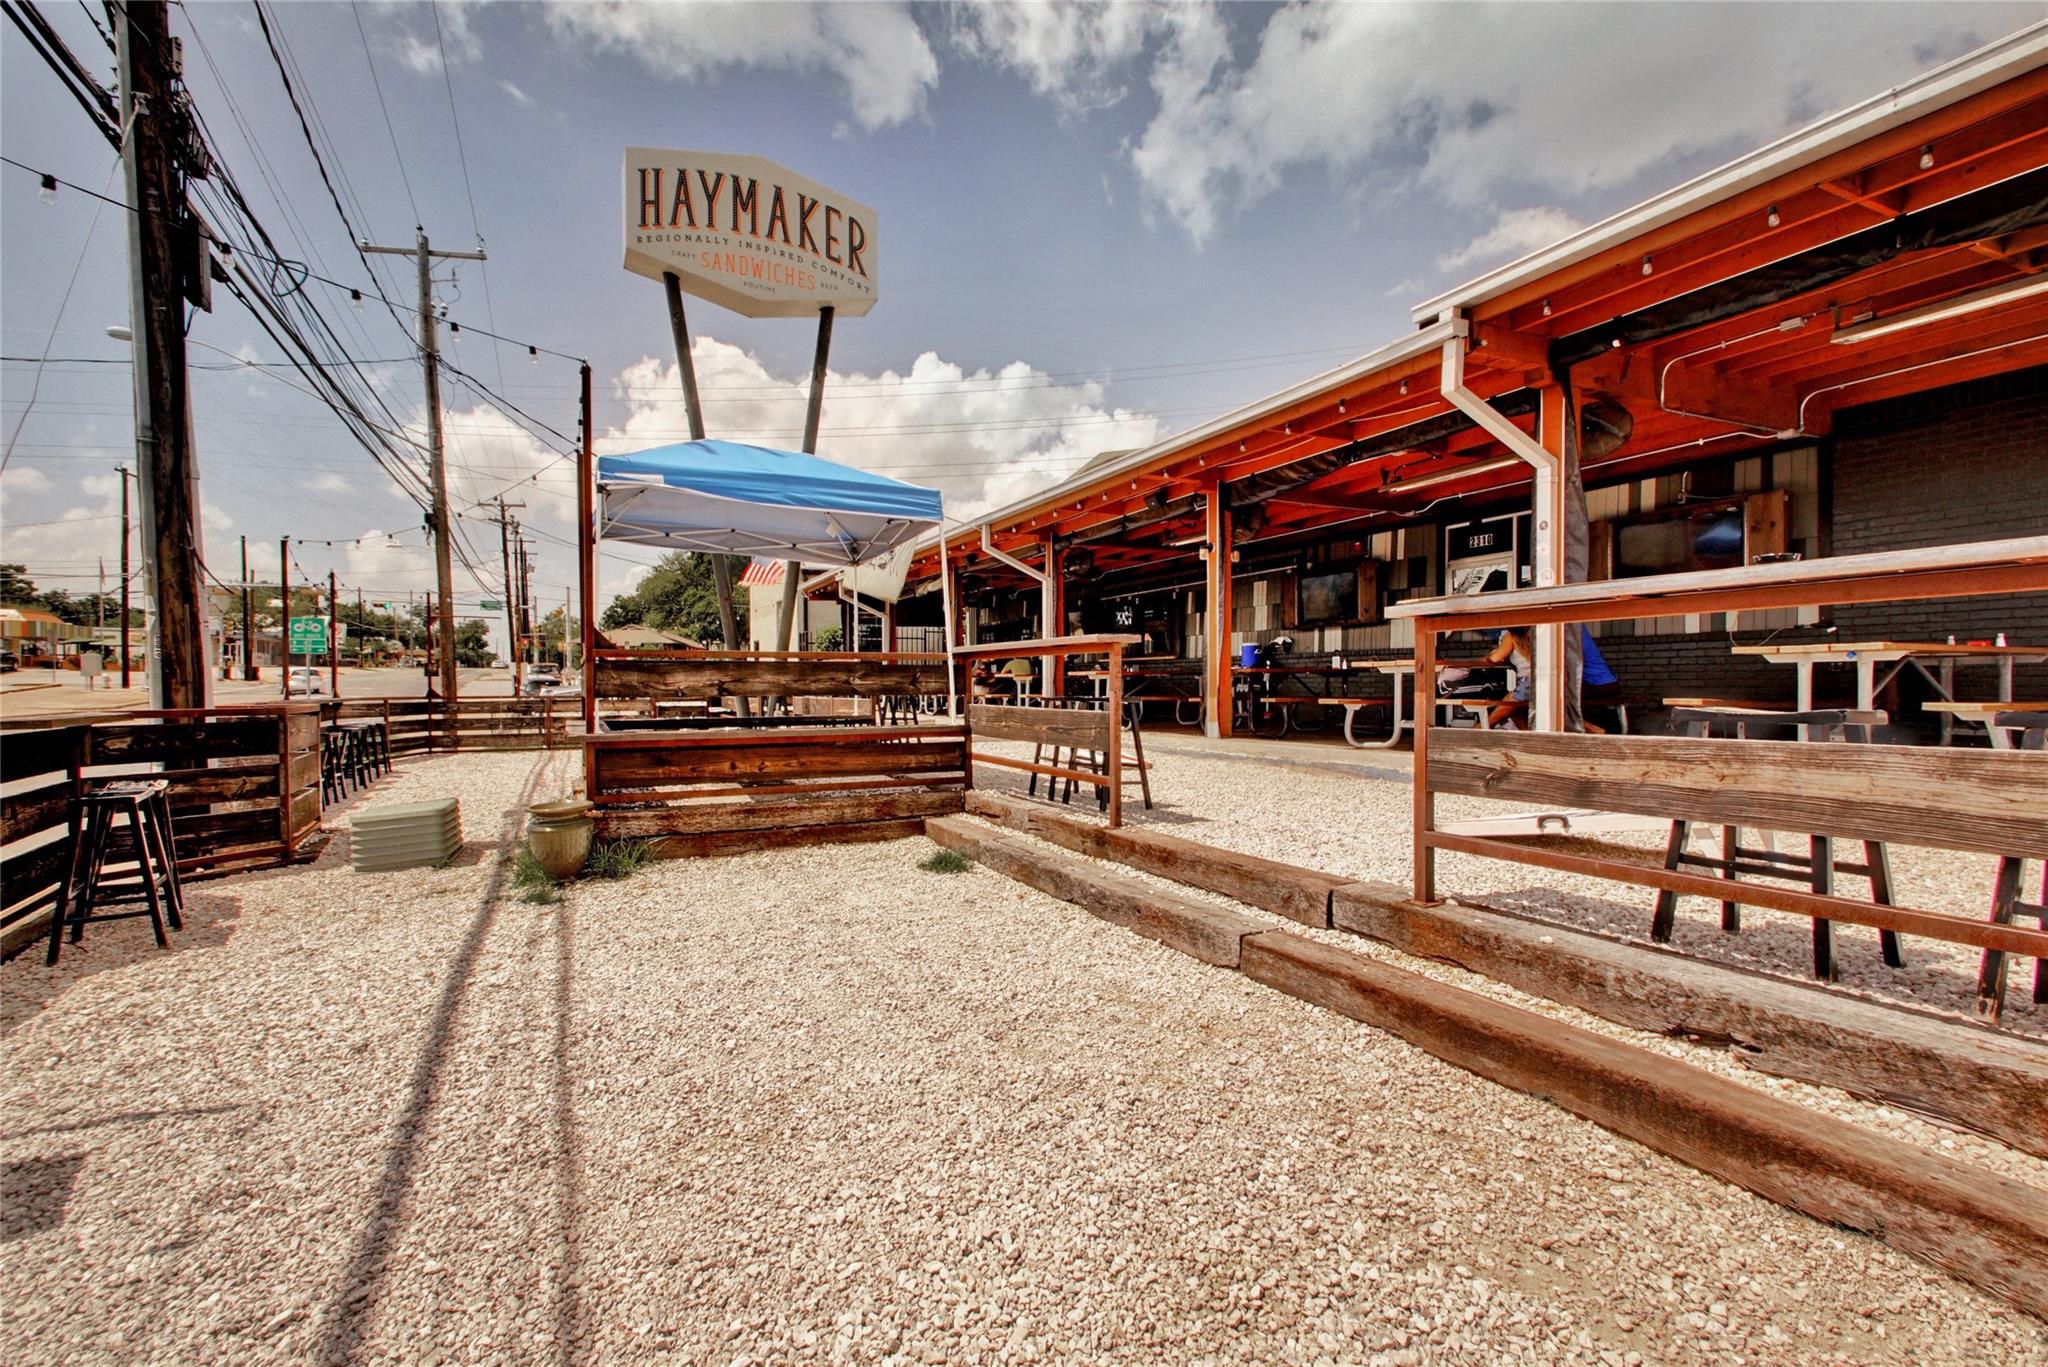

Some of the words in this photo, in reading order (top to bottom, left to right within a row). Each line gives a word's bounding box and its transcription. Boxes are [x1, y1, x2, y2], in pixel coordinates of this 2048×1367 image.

[638, 168, 871, 281] HAYMAKER
[636, 234, 729, 246] REGIONALLY
[738, 240, 803, 263] INSPIRED
[811, 260, 870, 294] COMFORT
[671, 249, 696, 260] CRAFT
[701, 251, 816, 290] SANDWICHES
[1470, 534, 1493, 547] 2310
